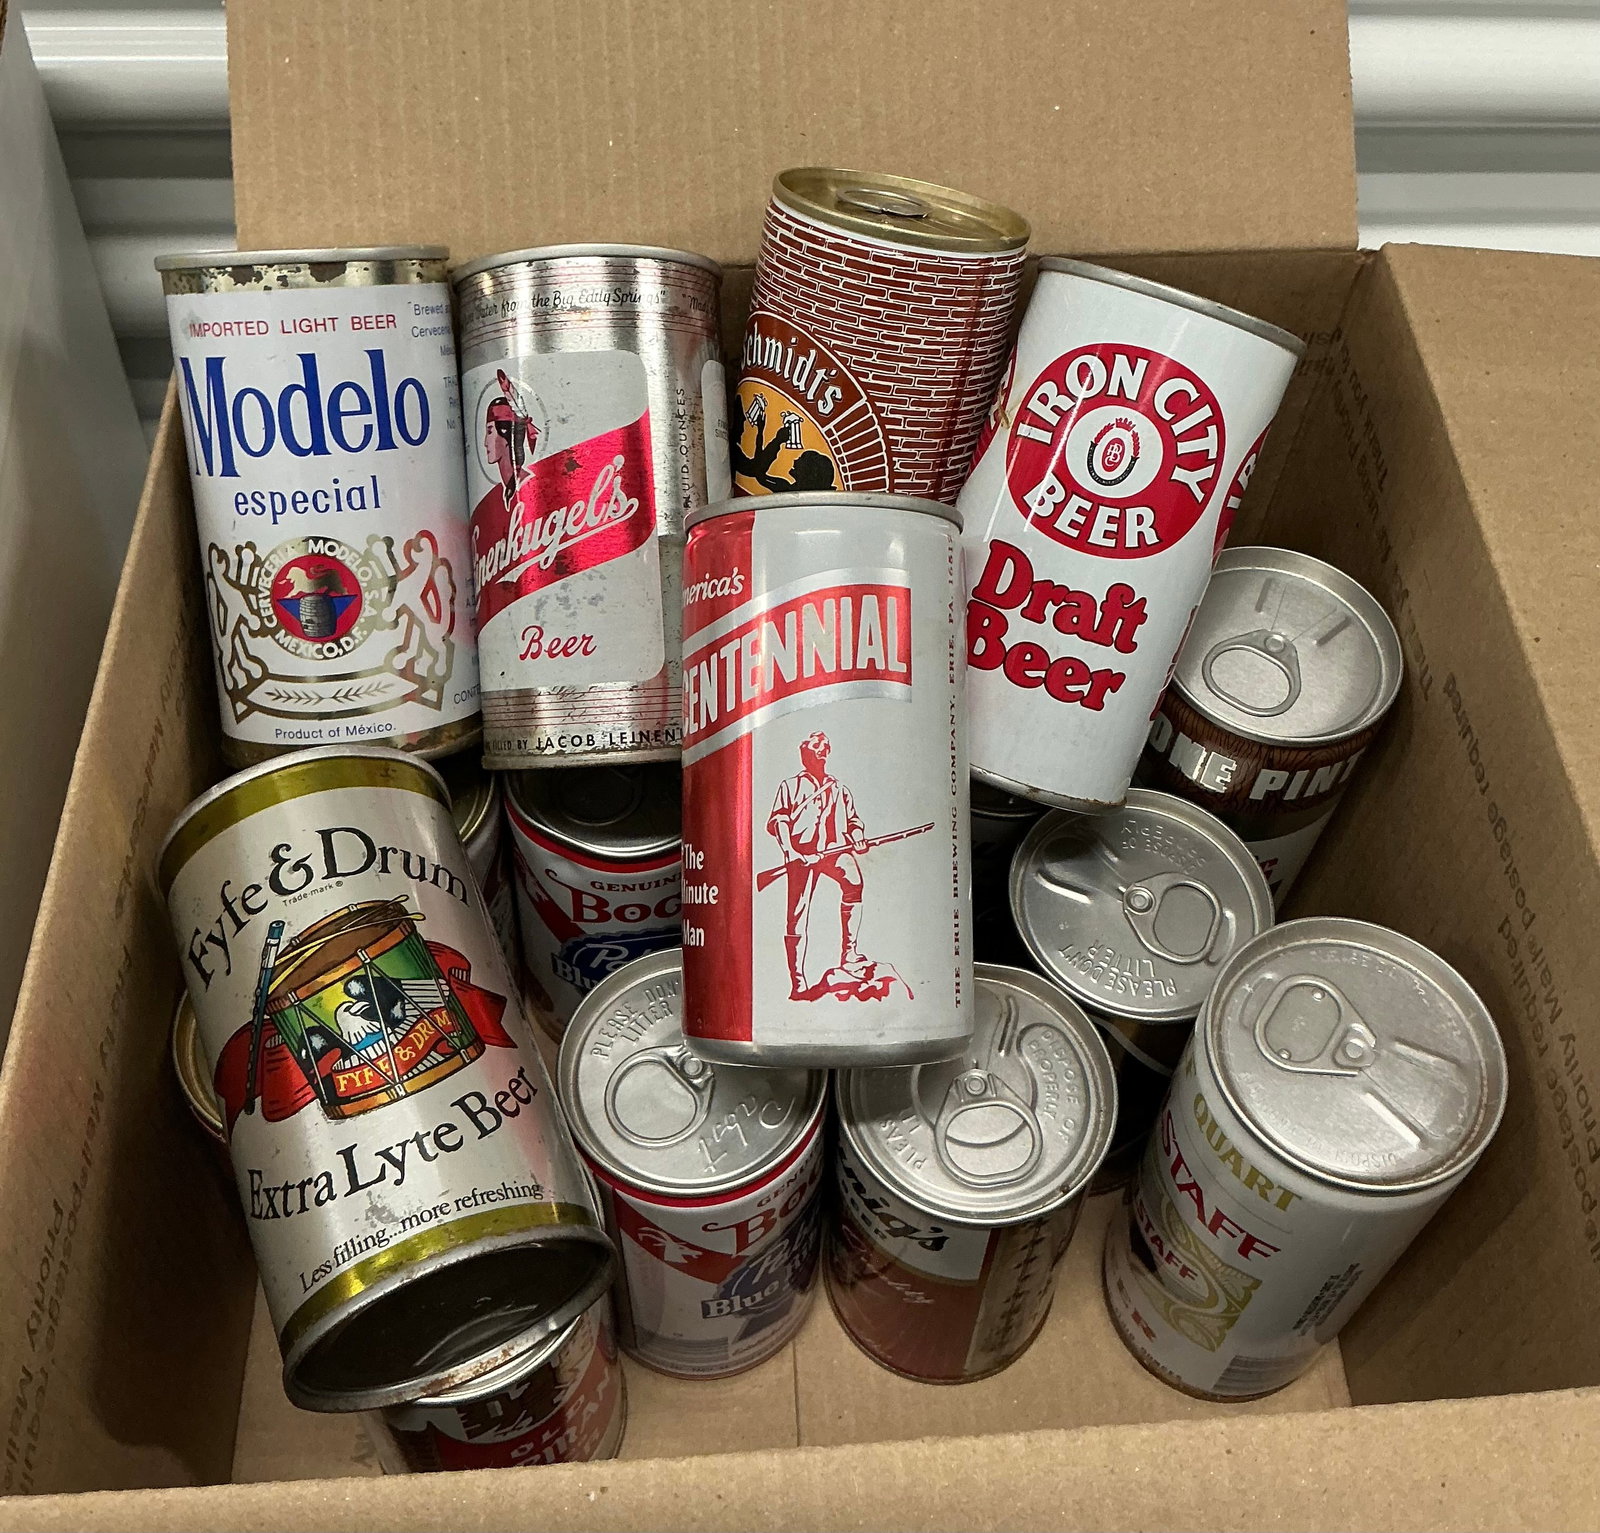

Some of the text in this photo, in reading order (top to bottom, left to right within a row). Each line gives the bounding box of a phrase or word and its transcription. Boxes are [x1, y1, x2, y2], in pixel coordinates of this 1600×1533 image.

[189, 313, 398, 338] IMPORTED LIGHT BEER
[501, 299, 526, 319] fro
[531, 292, 550, 309] the
[552, 290, 574, 309] Big
[180, 349, 431, 478] Modelo
[1016, 353, 1151, 446] IRON
[1153, 376, 1219, 504] CITY
[233, 474, 382, 525] especial
[470, 454, 639, 598] nenkugel's
[1023, 471, 1161, 549] BEER
[971, 538, 1148, 654] Draft
[519, 624, 598, 662] Beer
[966, 599, 1126, 711] Beer
[274, 721, 397, 741] Product of México.
[516, 739, 528, 750] BY
[535, 734, 596, 750] JACOB
[1149, 710, 1370, 801] ONE PINT
[1444, 670, 1490, 797] required
[684, 843, 705, 871] The
[950, 805, 960, 899] BREWING
[1486, 802, 1537, 925] postage
[187, 826, 470, 993] Fyfe & Drum
[282, 882, 334, 907] Trade-mark
[952, 908, 960, 957] ERIE
[589, 978, 680, 1060] PLEASE DON'
[620, 1001, 675, 1047] LITTER
[953, 966, 961, 1009] THE
[1103, 971, 1178, 999] PLEASE
[1498, 912, 1548, 1063] required
[336, 1045, 417, 1092] FYFE &
[247, 1066, 540, 1221] Extra Lyte Beer
[880, 1118, 928, 1171] PLEAS
[1192, 1092, 1303, 1213] QUART
[1545, 1066, 1598, 1216] postage
[839, 1158, 950, 1252] nig's
[1161, 1108, 1282, 1262] STAFF
[299, 1256, 334, 1294] Less
[453, 1180, 545, 1211] refreshing
[1136, 1199, 1199, 1281] STAFF
[705, 1279, 781, 1318] Blue
